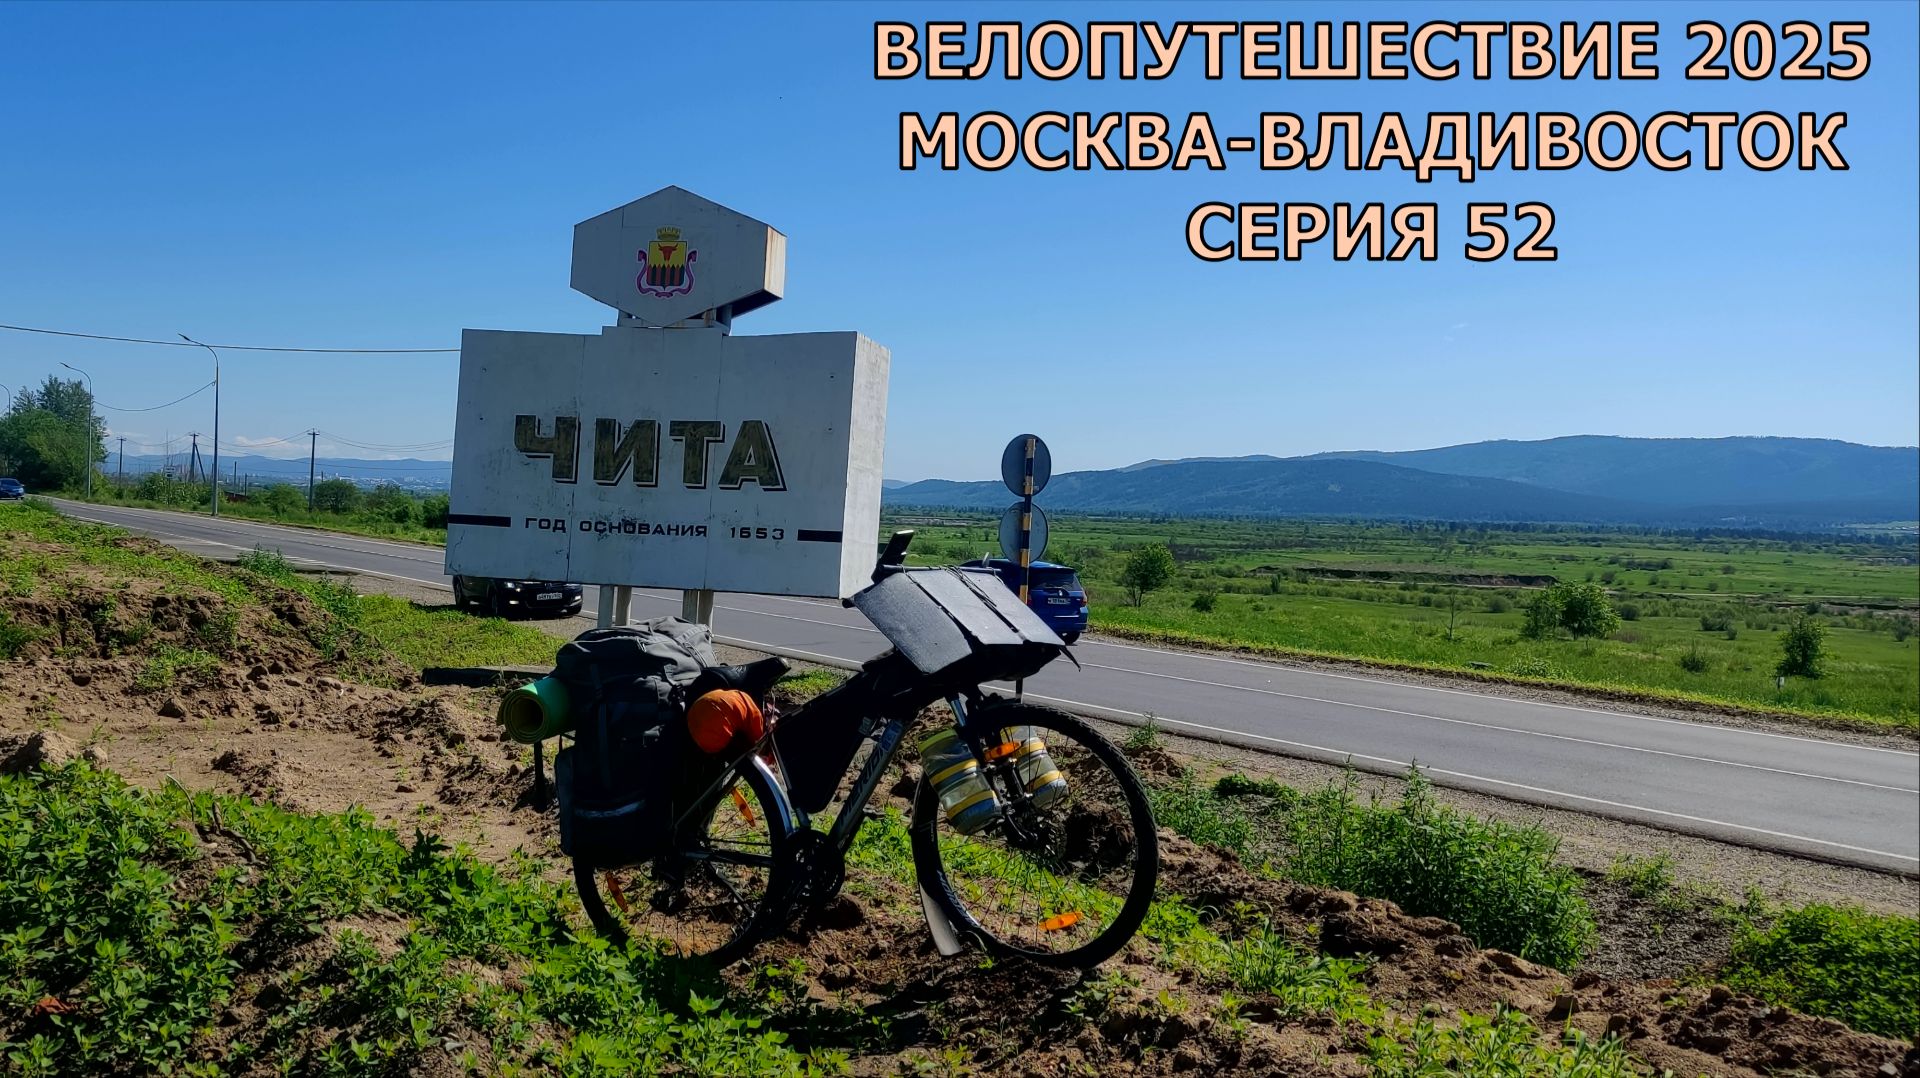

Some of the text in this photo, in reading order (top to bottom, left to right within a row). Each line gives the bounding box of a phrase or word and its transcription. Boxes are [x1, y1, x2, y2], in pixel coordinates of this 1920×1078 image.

[514, 415, 787, 491] ЧИТА
[525, 517, 785, 541] ГОД ОСНОВАНИЯ 1653
